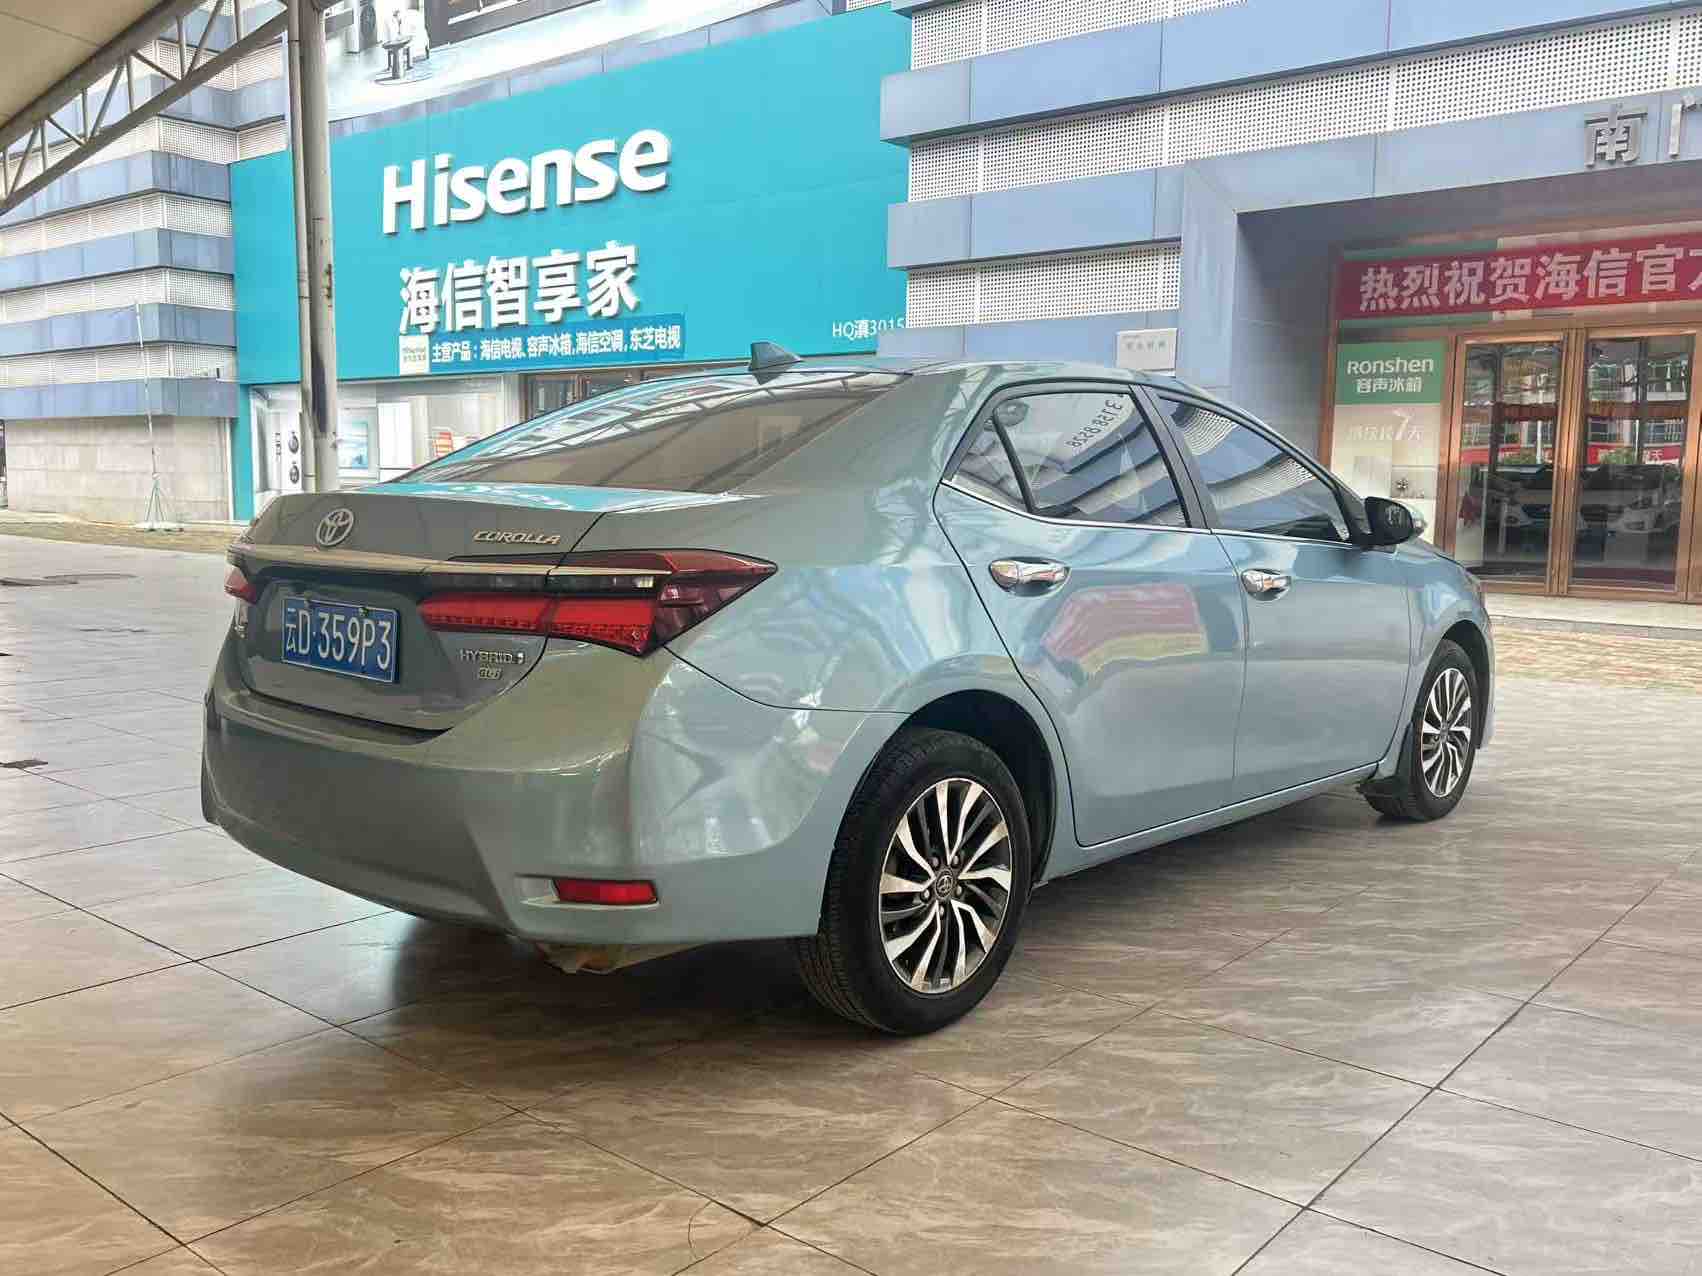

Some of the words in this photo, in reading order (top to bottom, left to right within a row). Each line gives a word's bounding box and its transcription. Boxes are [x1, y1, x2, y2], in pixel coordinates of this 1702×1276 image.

[382, 128, 672, 235] Hisense
[399, 239, 641, 334] 海信智享家
[1347, 356, 1434, 375] Ronshen
[1356, 376, 1422, 394] 容声冰箱
[473, 529, 561, 546] COROLLA
[460, 649, 513, 665] HYBRID
